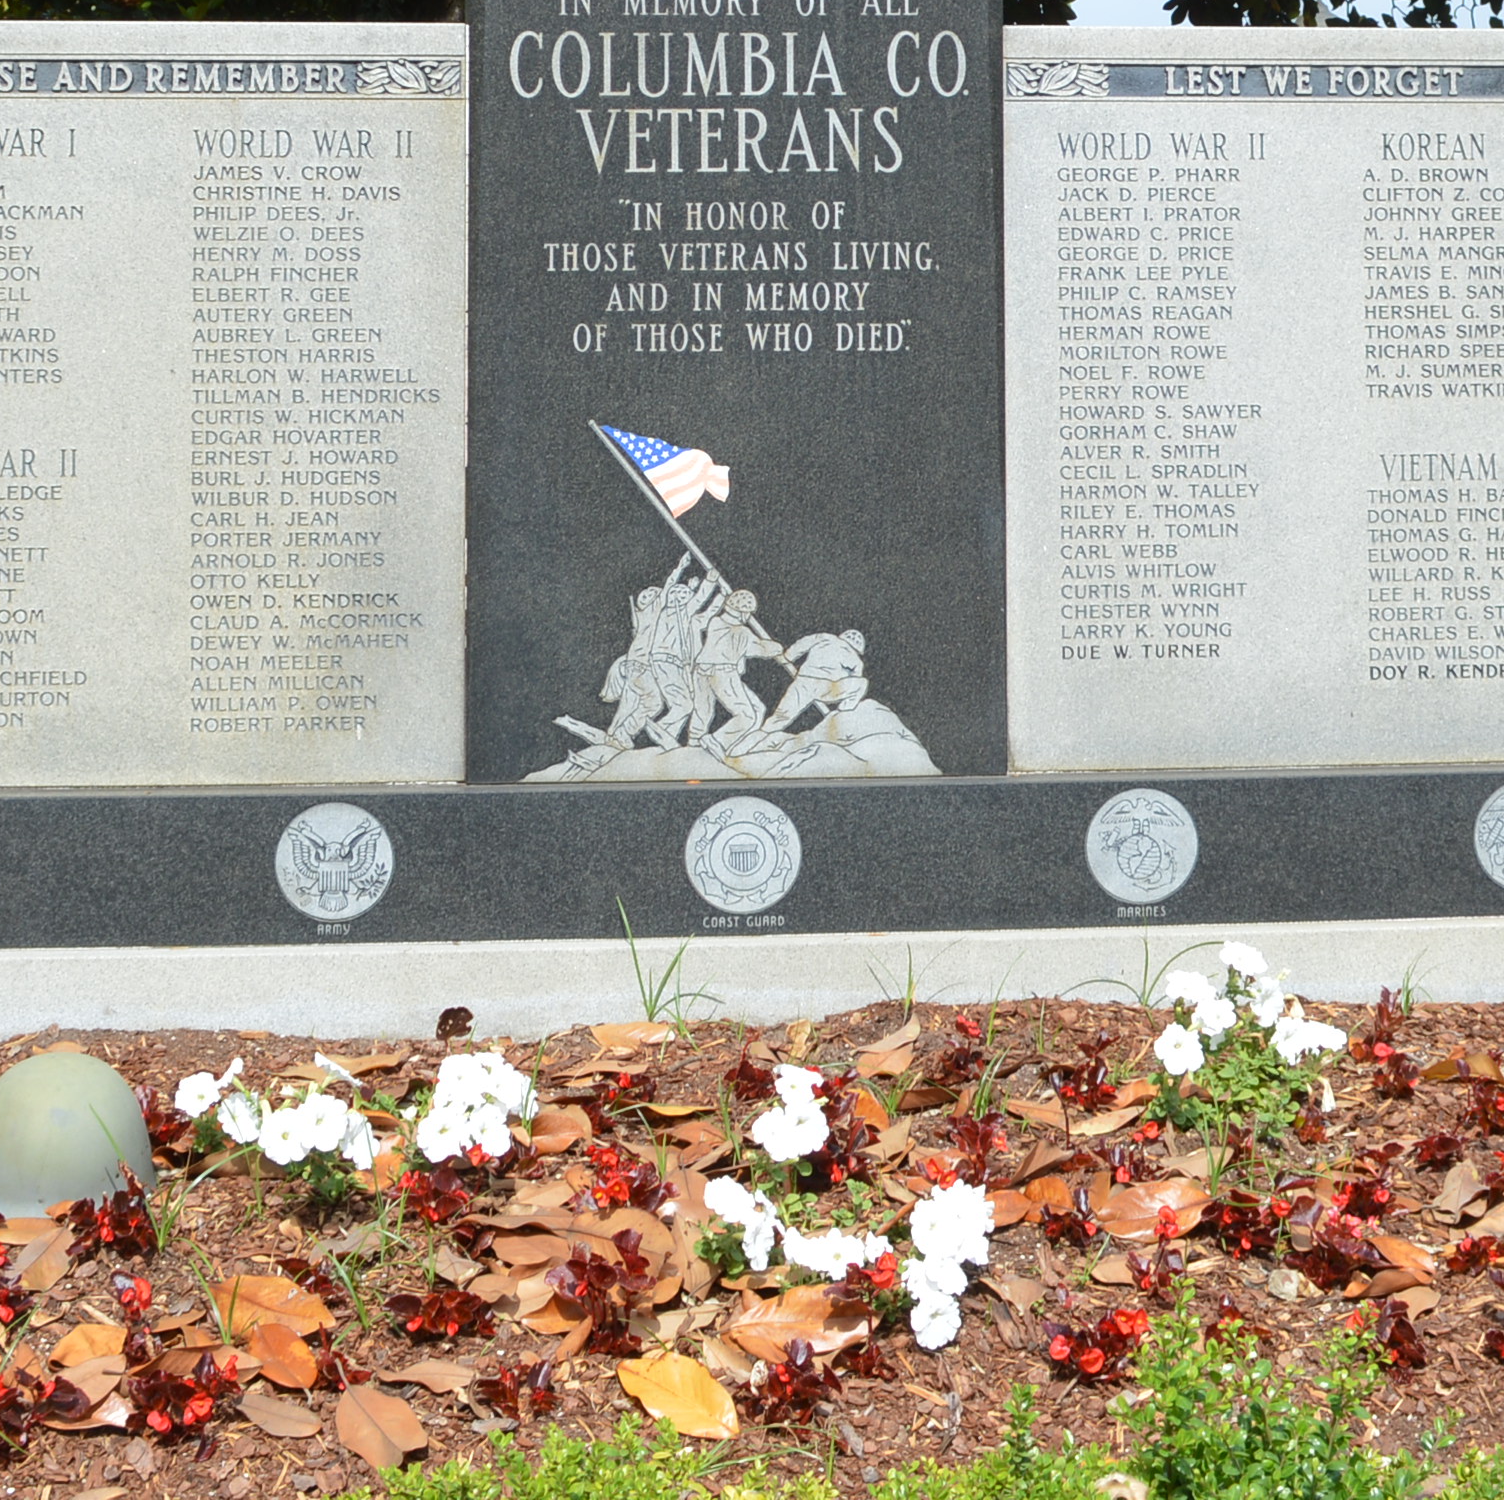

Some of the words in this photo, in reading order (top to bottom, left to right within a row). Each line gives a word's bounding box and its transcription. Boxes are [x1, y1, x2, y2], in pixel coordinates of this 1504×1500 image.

[510, 31, 846, 98] COLUMBIA
[887, 31, 968, 97] CO.
[53, 62, 133, 93] AND
[145, 62, 346, 93] REMEMBER
[1164, 67, 1246, 97] LEST
[1263, 67, 1312, 97] WE
[1328, 67, 1465, 97] FORGET
[69, 129, 75, 157] I
[193, 129, 292, 158] WORLD
[313, 130, 374, 159] WAR
[395, 130, 412, 158] II
[576, 107, 902, 174] VETERANS
[1058, 132, 1151, 160] WORLD
[1170, 133, 1228, 161] WAR
[1250, 133, 1264, 160] II
[1382, 133, 1484, 161] KOREAN
[1057, 168, 1138, 182] GEORGE
[1149, 168, 1164, 181] P.
[1176, 168, 1240, 182] PHARR
[1363, 188, 1443, 202] CLIFTON
[1454, 188, 1469, 201] Z.
[686, 202, 789, 230] HONOR
[812, 201, 845, 229] OF
[1364, 207, 1441, 221] JOHNNY
[544, 243, 635, 271] THOSE
[659, 242, 807, 271] VETERANS
[1364, 247, 1428, 260] SELMA
[192, 268, 259, 282] RALPH
[271, 268, 358, 282] FINCHER
[606, 283, 667, 311] AND
[693, 283, 722, 311] IN
[745, 282, 869, 311] MEMORY
[1365, 285, 1428, 300] JAMES
[1439, 286, 1455, 299] B.
[193, 308, 272, 323] AUTERY
[283, 308, 352, 322] GREEN
[1058, 306, 1141, 321] THOMAS
[1153, 306, 1232, 320] REAGAN
[573, 324, 607, 352] OF
[632, 323, 723, 352] THOSE
[745, 323, 812, 351] WHO
[1059, 326, 1142, 340] HERMAN
[1154, 326, 1210, 340] ROWE
[192, 349, 287, 363] THESTON
[299, 349, 374, 363] HARRIS
[1060, 346, 1160, 360] MORILTON
[1171, 345, 1227, 359] ROWE
[193, 389, 280, 404] TILLMAN
[293, 390, 309, 404] B.
[322, 389, 440, 404] HENDRICKS
[1060, 386, 1121, 400] PERRY
[1132, 385, 1188, 400] ROWE
[1366, 384, 1432, 398] TRAVIS
[192, 430, 262, 445] EDGAR
[273, 430, 381, 446] HOVARTER
[60, 449, 77, 477] II
[1380, 453, 1497, 481] VIETNAM
[1368, 509, 1447, 523] DONALD
[191, 533, 271, 547] PORTER
[283, 532, 382, 547] JERMANY
[1368, 528, 1449, 543] THOMAS
[1459, 528, 1476, 542] G.
[1061, 545, 1112, 559] CARL
[1122, 544, 1177, 558] WEBB
[1062, 565, 1115, 579] ALVIS
[1126, 564, 1216, 578] WHITLOW
[191, 574, 246, 589] OTTO
[258, 574, 320, 588] KELLY
[1061, 604, 1150, 619] CHESTER
[1161, 603, 1218, 617] WYNN
[1062, 646, 1100, 659] DUE
[1114, 645, 1131, 658] W.
[1142, 644, 1219, 658] TURNER
[1369, 646, 1425, 661] DAVID
[191, 656, 249, 671] NOAH
[261, 655, 344, 671] MEELER
[1370, 666, 1407, 680] DOY
[1419, 665, 1435, 679] R.
[191, 677, 256, 691] ALLEN
[269, 675, 364, 693] MILLICAN
[191, 717, 273, 732] ROBERT
[284, 716, 366, 732] PARKER
[1117, 905, 1166, 917] MARINES
[317, 923, 350, 935] ARMY
[703, 916, 740, 928] COAST
[746, 915, 785, 927] GUARD
